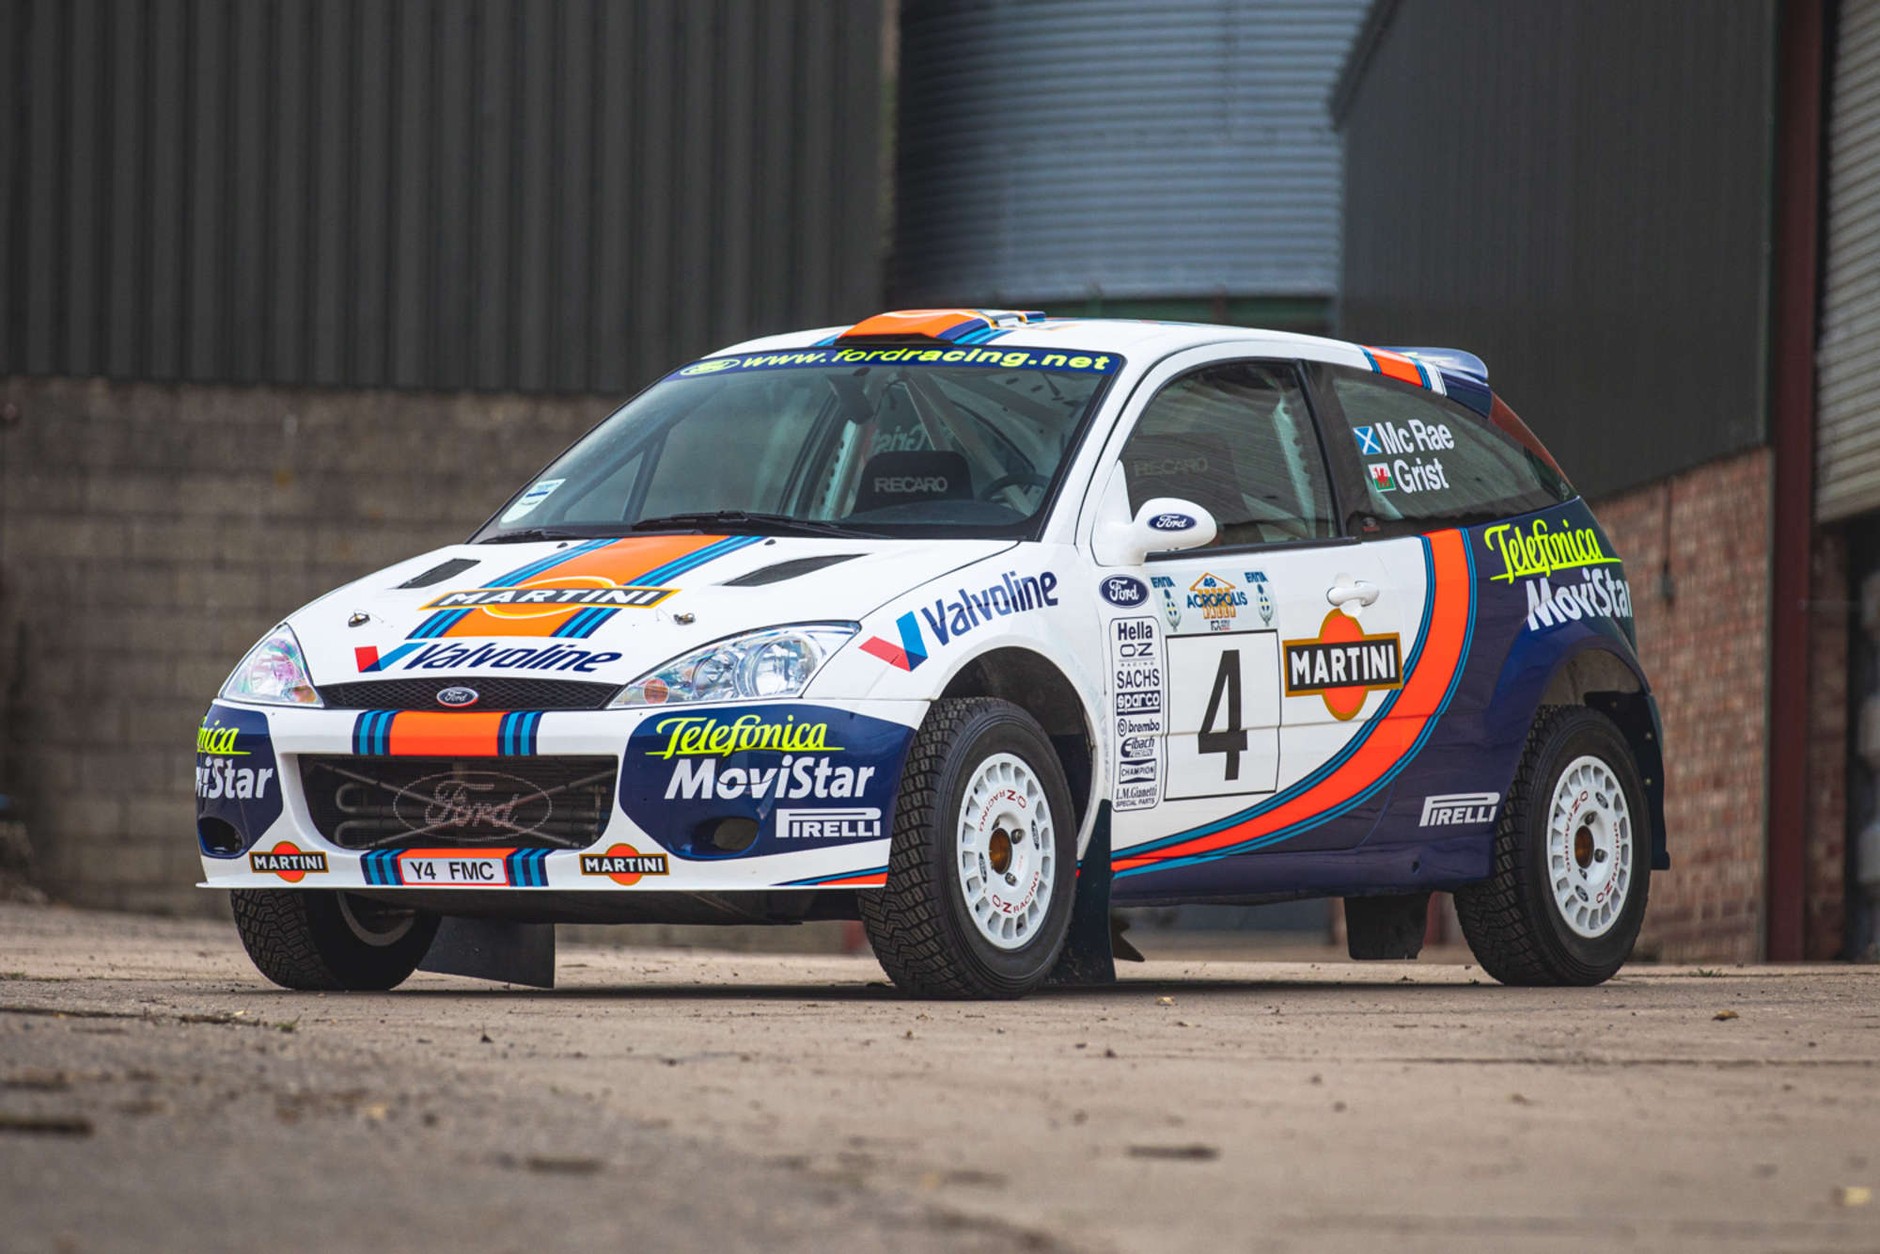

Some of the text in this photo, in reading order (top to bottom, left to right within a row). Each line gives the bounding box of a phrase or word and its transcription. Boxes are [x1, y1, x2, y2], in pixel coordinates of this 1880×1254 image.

[742, 347, 1110, 371] www.fordracing.net
[1408, 418, 1455, 452] Rae
[873, 475, 948, 493] RECARO
[1393, 457, 1450, 494] Grist
[1156, 515, 1188, 528] Ford
[438, 589, 659, 605] MARTINI
[1108, 579, 1140, 601] Ford
[1187, 591, 1248, 609] ACROPOLIS
[921, 571, 1058, 646] Valvoline
[1118, 621, 1153, 641] Hella
[402, 642, 623, 673] Valvoline
[1291, 645, 1396, 686] MARTINI
[1116, 668, 1160, 689] SACHS
[444, 691, 468, 702] Ford
[1117, 693, 1160, 713] sparco
[1128, 719, 1160, 733] brembo
[1198, 649, 1248, 781] 4
[1121, 736, 1155, 758] Eibach
[664, 754, 875, 800] MoviStar
[1121, 766, 1154, 777] CHAMPION
[424, 780, 520, 828] Ford
[979, 789, 1006, 832] RACING
[1419, 792, 1500, 827] PIRELLI
[775, 807, 881, 838] PIRELLI
[254, 855, 325, 870] MARTINI
[410, 861, 495, 880] Y4 FMC
[584, 857, 665, 873] MARTINI
[1013, 871, 1040, 914] RACING
